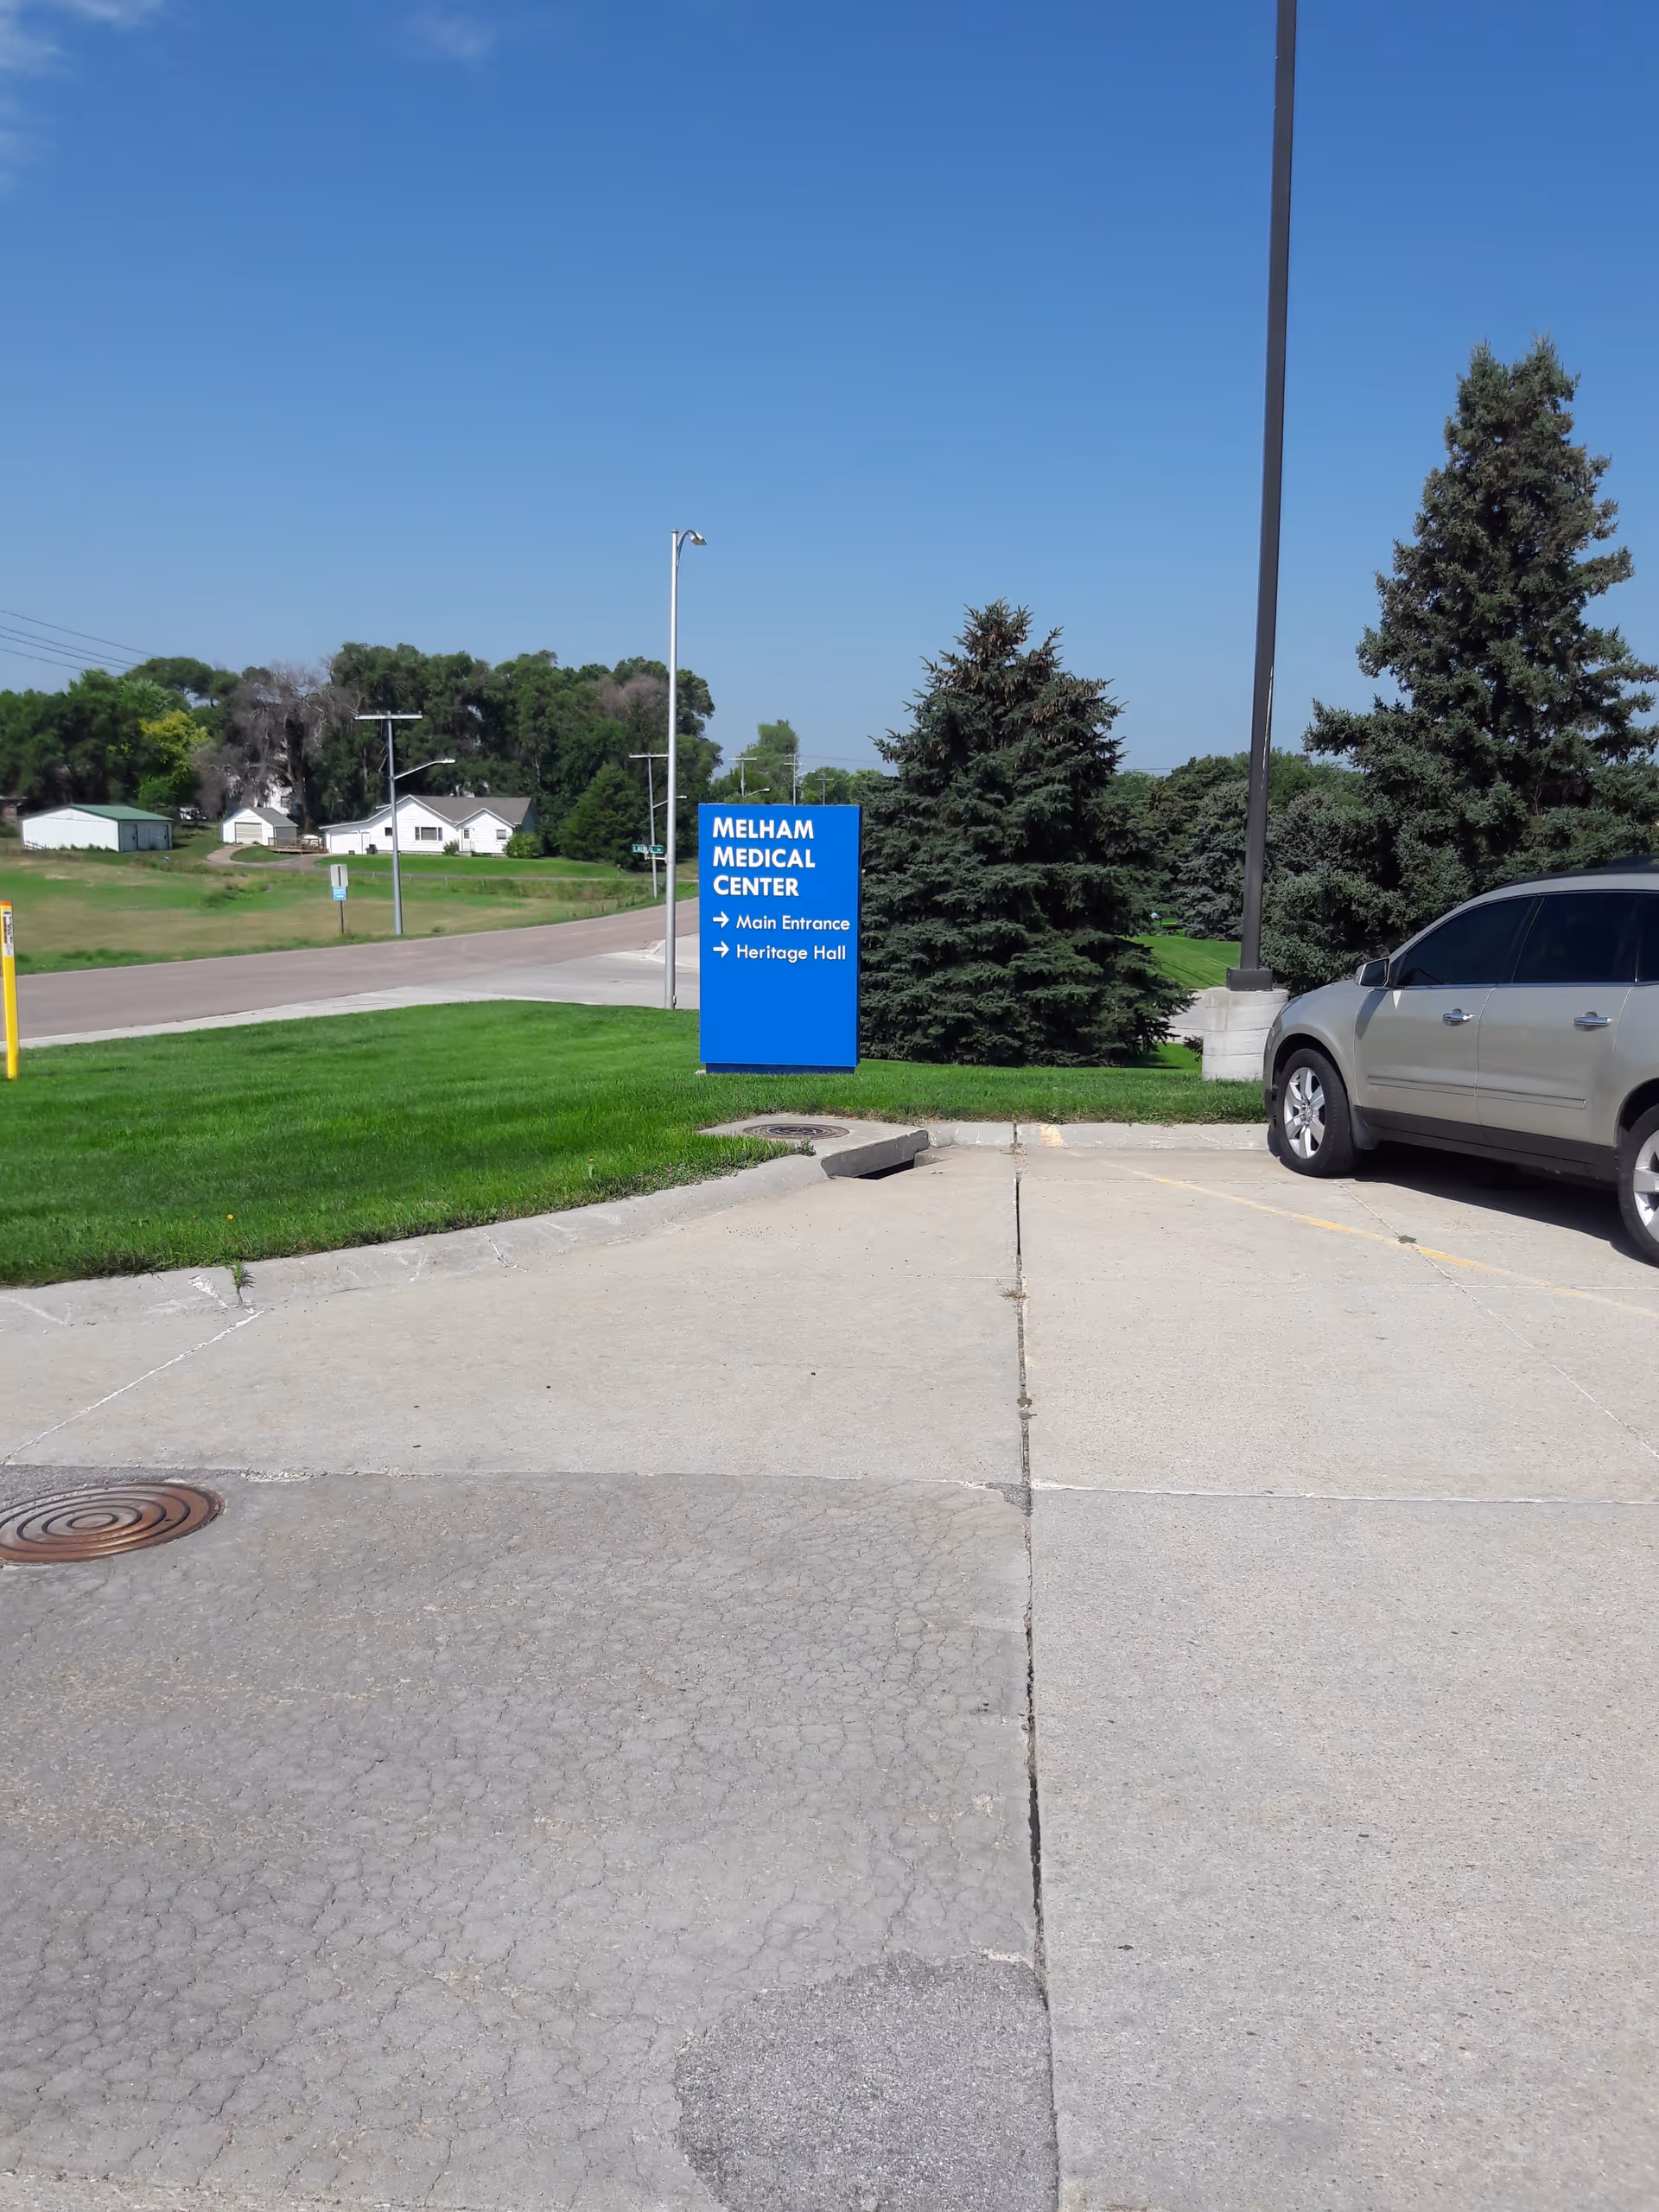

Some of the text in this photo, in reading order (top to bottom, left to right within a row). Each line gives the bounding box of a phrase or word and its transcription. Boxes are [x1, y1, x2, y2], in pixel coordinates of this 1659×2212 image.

[713, 817, 814, 839] MELHAM
[713, 847, 815, 868] MEDICAL
[714, 875, 798, 896] CENTER
[736, 915, 849, 930] Main Entrance
[737, 944, 845, 963] Heritage Hall
